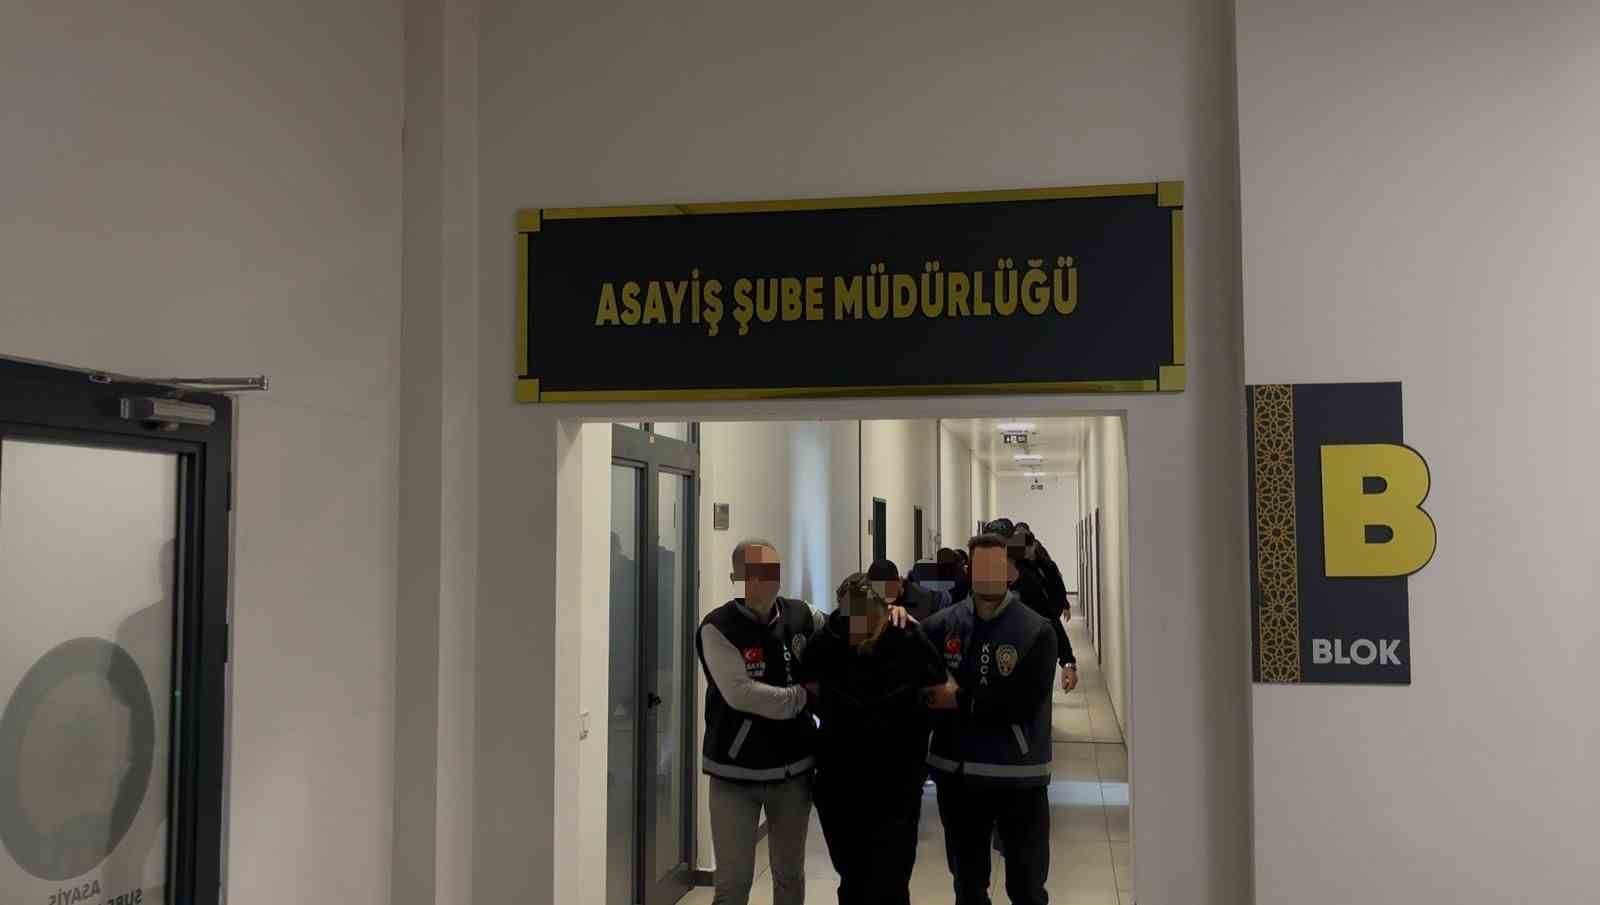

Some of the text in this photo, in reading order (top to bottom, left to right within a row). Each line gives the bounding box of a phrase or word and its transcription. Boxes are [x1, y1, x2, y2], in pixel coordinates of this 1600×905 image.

[595, 256, 1079, 337] ASAYİŞ ŞUBE MÜDÜRLÜĞÜ
[1319, 443, 1437, 578] B
[1312, 638, 1402, 665] BLOK
